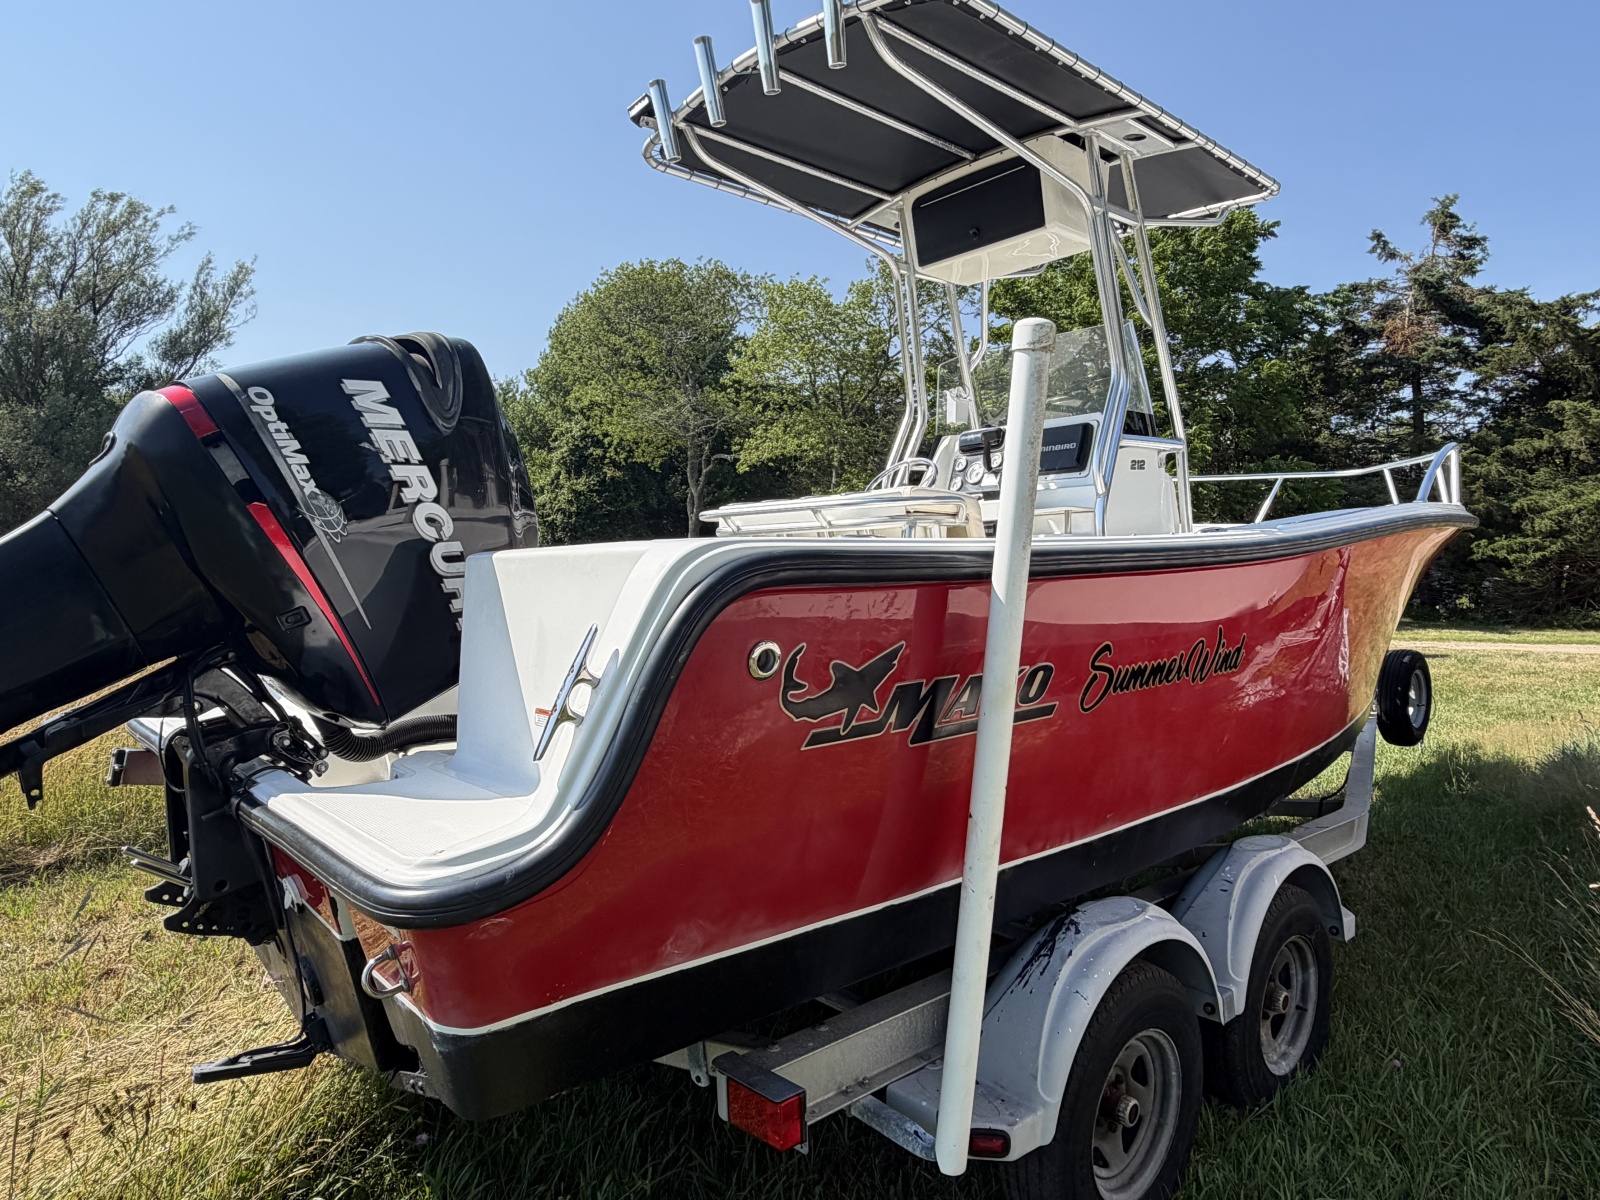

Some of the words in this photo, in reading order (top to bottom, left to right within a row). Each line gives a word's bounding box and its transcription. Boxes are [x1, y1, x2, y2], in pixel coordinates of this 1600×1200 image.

[248, 386, 321, 496] OptiMax
[1130, 459, 1146, 471] 212
[341, 379, 464, 631] MERCU
[878, 662, 1056, 747] MAO
